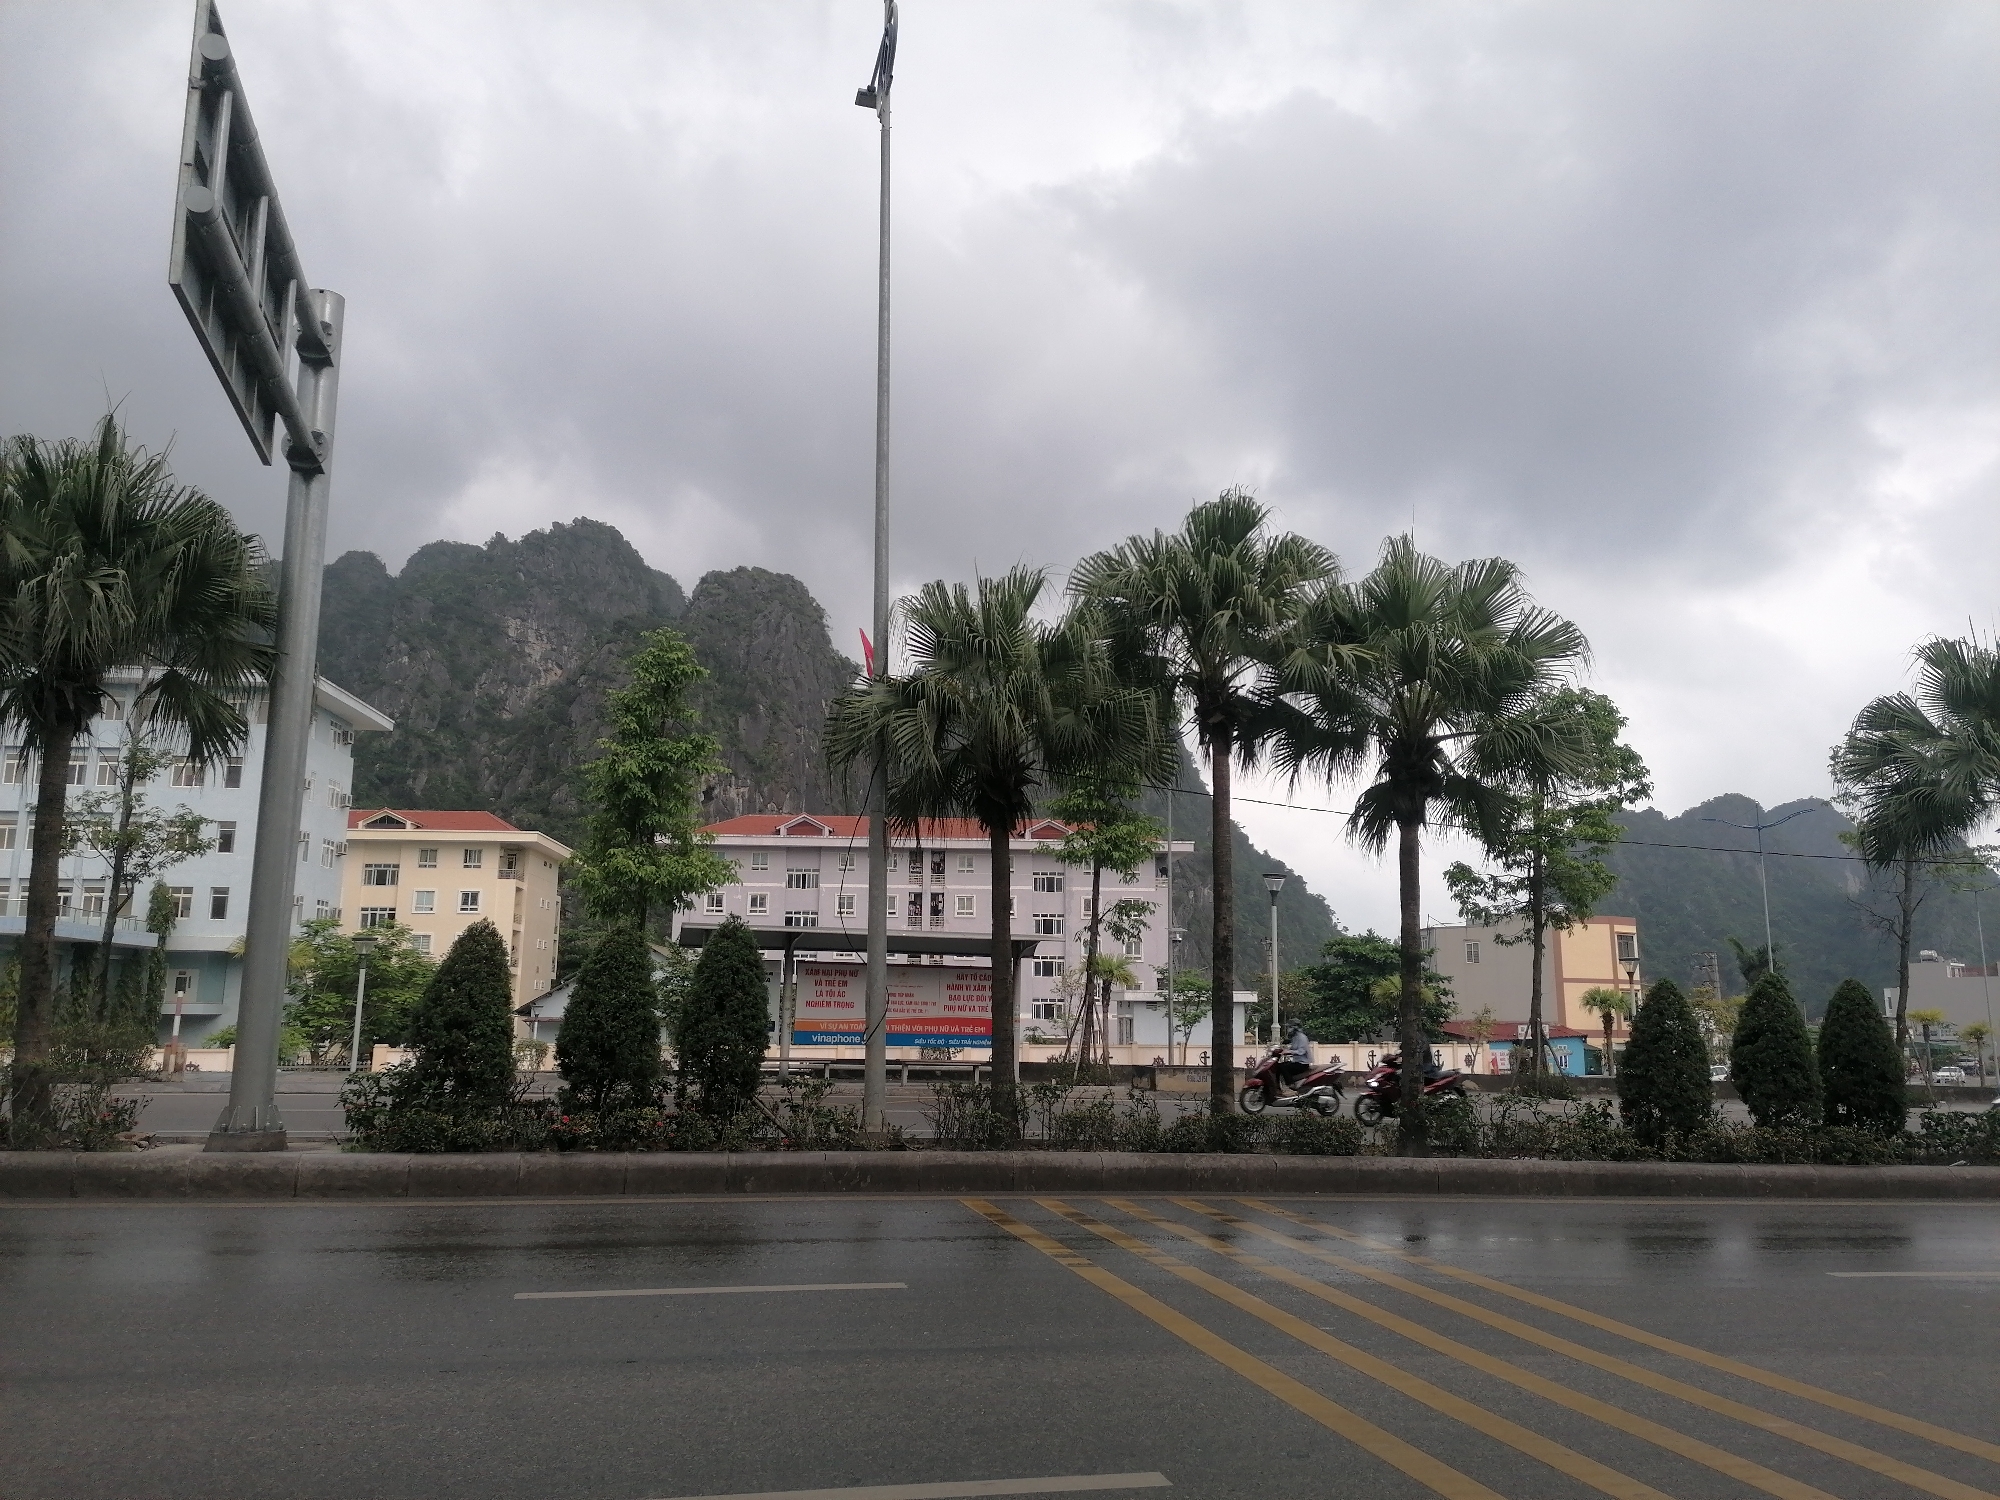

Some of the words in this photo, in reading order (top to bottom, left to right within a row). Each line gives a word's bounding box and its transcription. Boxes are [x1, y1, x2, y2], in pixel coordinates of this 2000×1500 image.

[805, 967, 820, 976] XÂM
[834, 969, 847, 978] PHỤ
[849, 969, 859, 977] NỮ
[814, 978, 823, 987] VÀ
[825, 978, 836, 987] TRẺ
[946, 983, 963, 991] HÀNH
[973, 983, 986, 992] XÂM
[816, 989, 823, 997] LÀ
[826, 989, 835, 999] TỘI
[837, 989, 846, 997] ÁC
[948, 994, 961, 1003] BẠO
[963, 994, 974, 1003] LỰC
[805, 999, 831, 1007] NGHIÊM
[833, 1001, 854, 1010] TRỌNG
[944, 1004, 956, 1014] PHỤ
[958, 1004, 967, 1012] NỮ
[978, 1004, 988, 1012] TRẺ
[828, 1022, 838, 1031] SỰ
[891, 1024, 910, 1032] THIỆN
[924, 1026, 939, 1034] PHỤ
[812, 1033, 860, 1044] vinaphone
